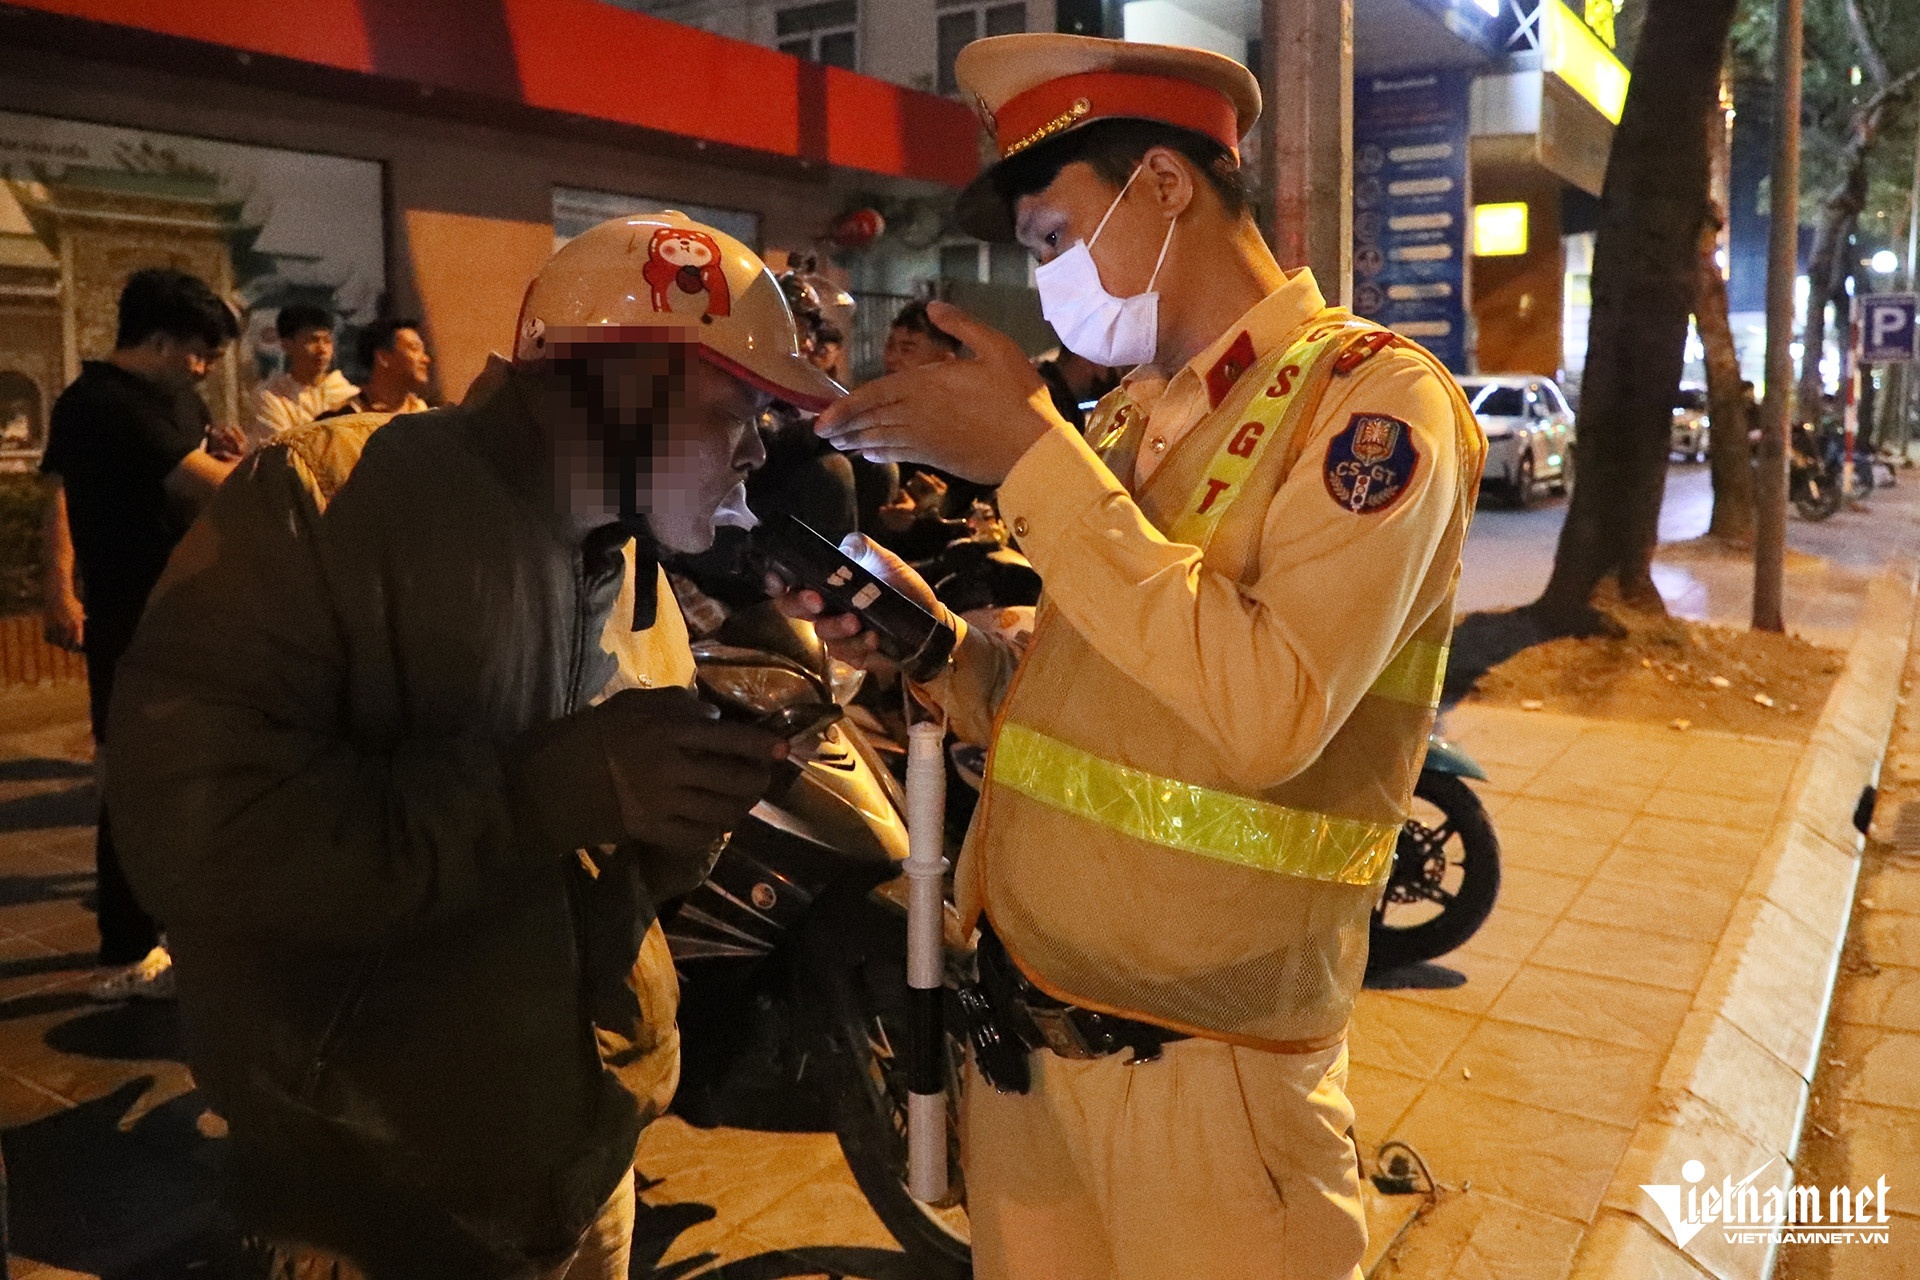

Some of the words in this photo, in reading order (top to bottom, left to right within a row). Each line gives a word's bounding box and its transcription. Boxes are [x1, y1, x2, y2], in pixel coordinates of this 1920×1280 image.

[1872, 306, 1907, 346] P
[1336, 462, 1361, 476] CS
[1371, 465, 1397, 485] GT
